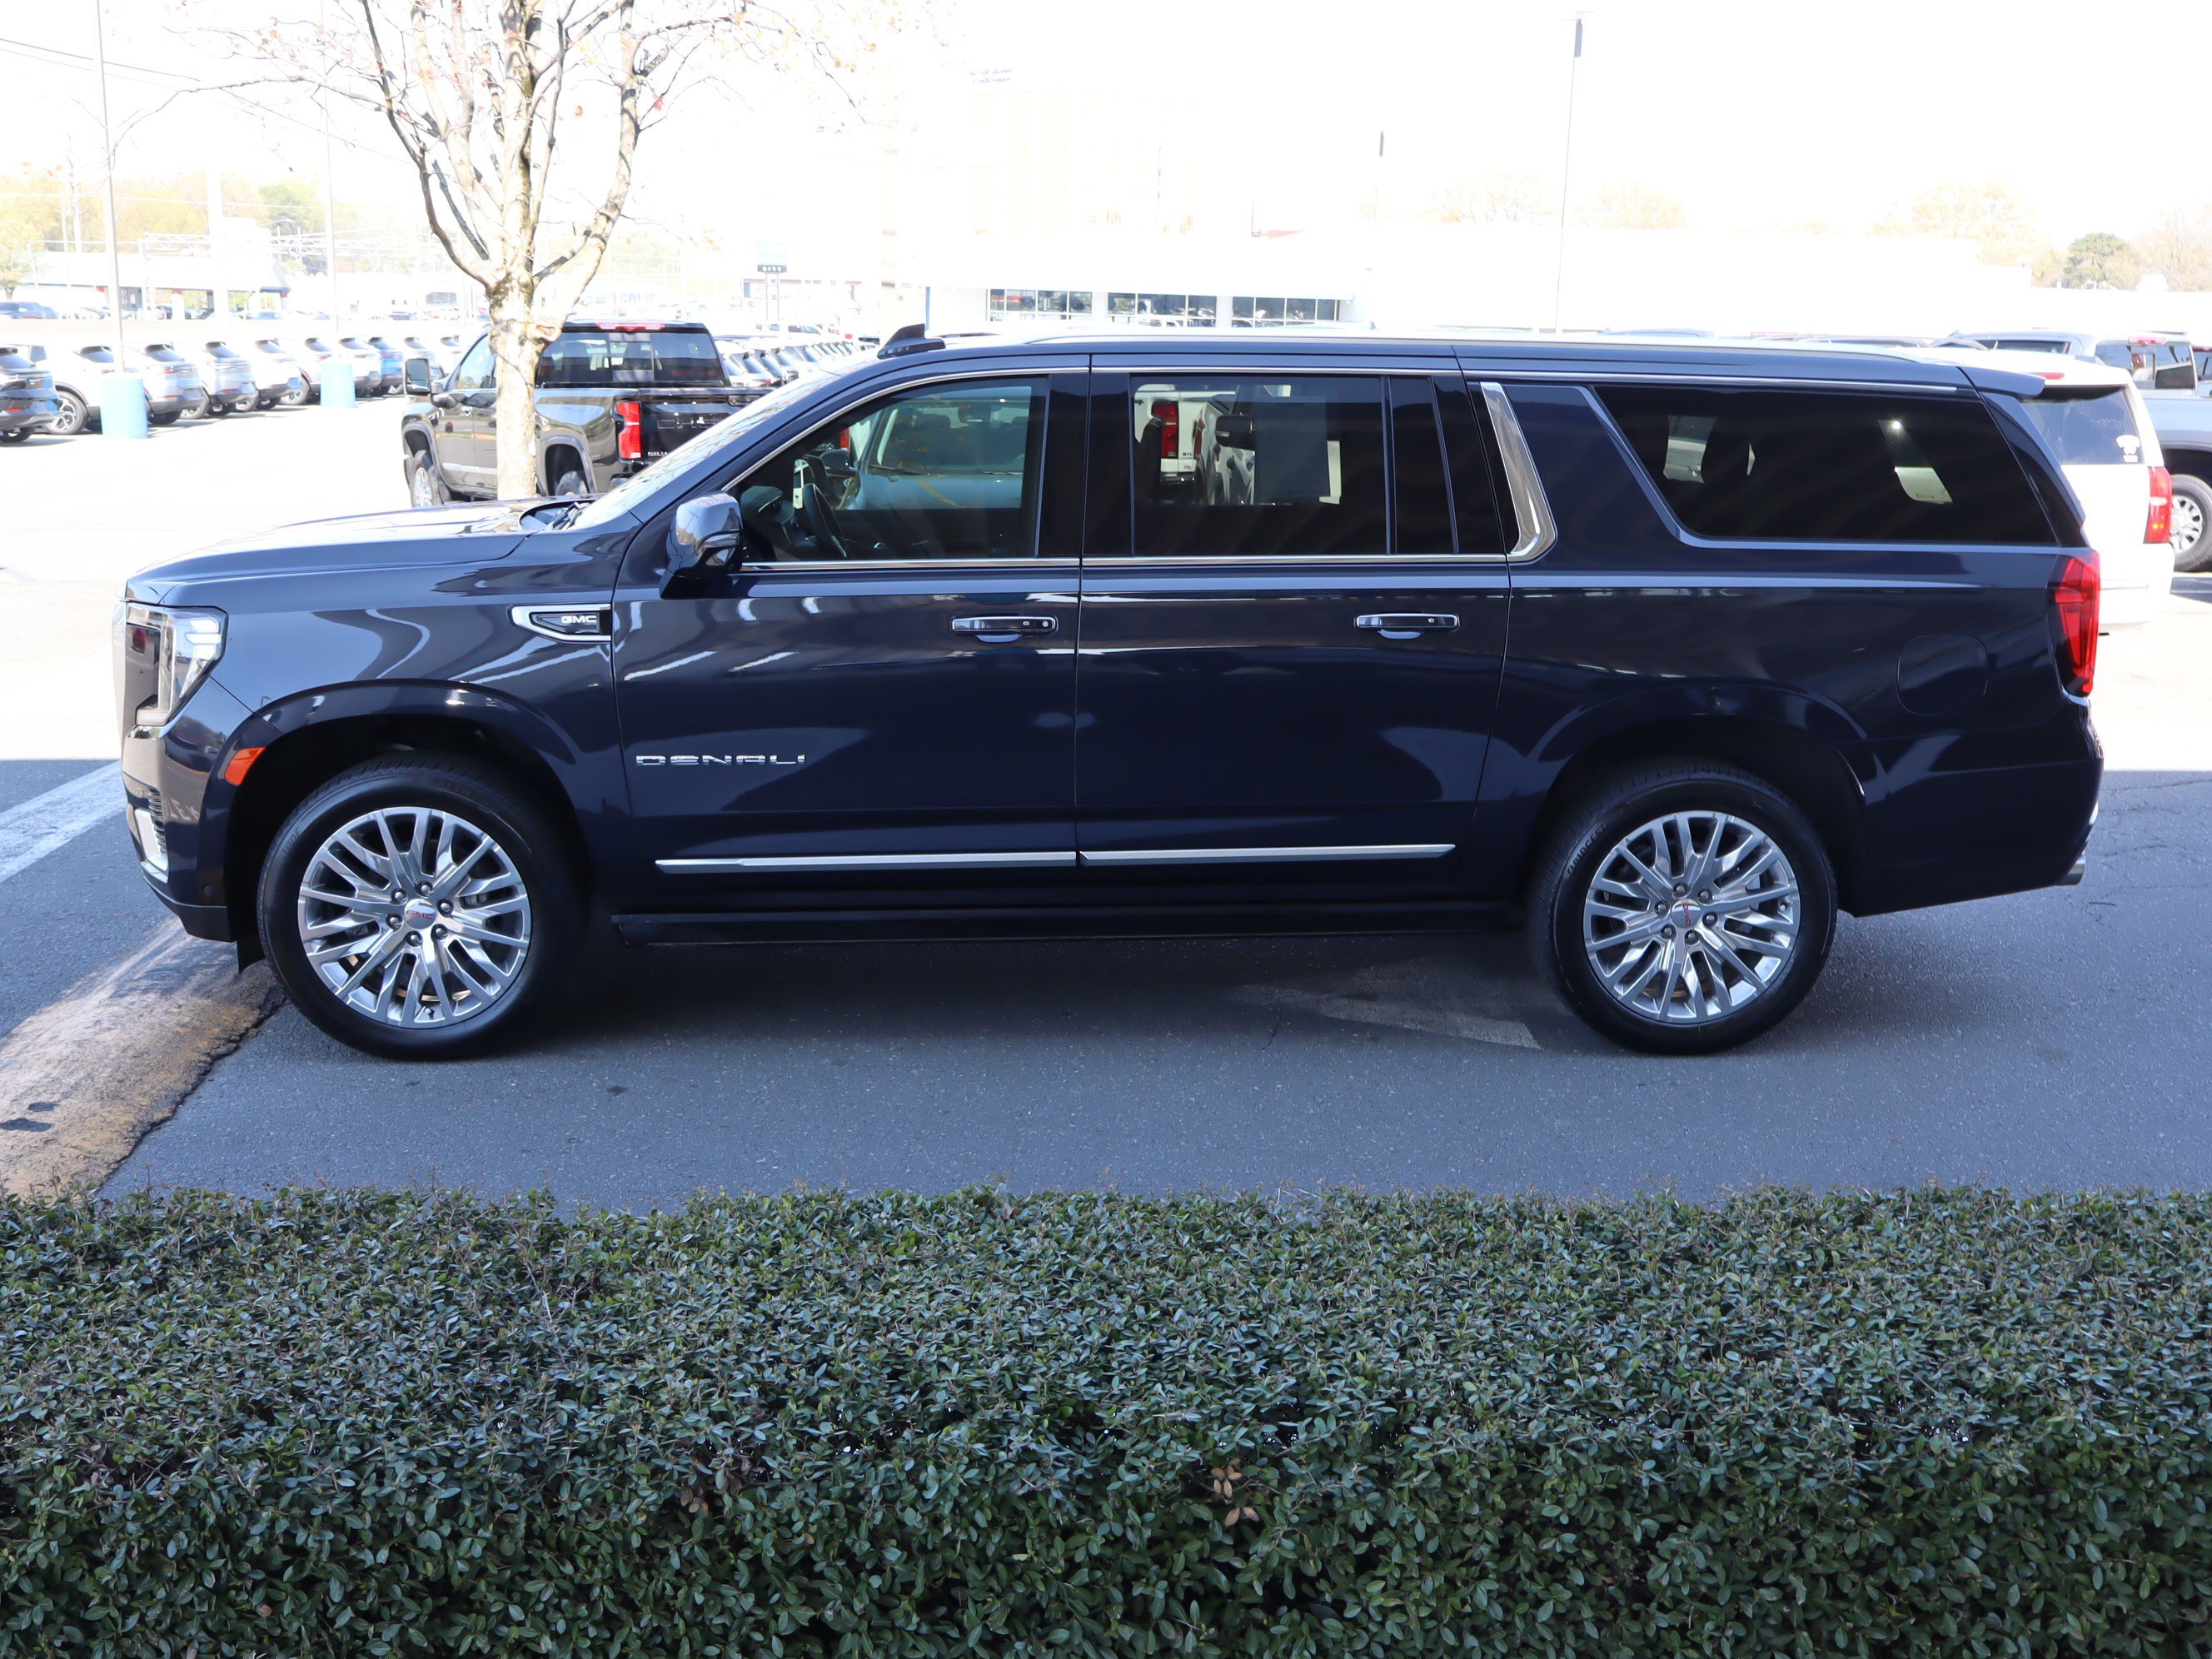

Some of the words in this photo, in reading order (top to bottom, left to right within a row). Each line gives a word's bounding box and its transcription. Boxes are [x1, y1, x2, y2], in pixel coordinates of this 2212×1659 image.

[560, 615, 597, 624] GMC
[635, 755, 805, 766] DENALI
[406, 909, 434, 920] GMC
[1682, 901, 1691, 926] GMC
